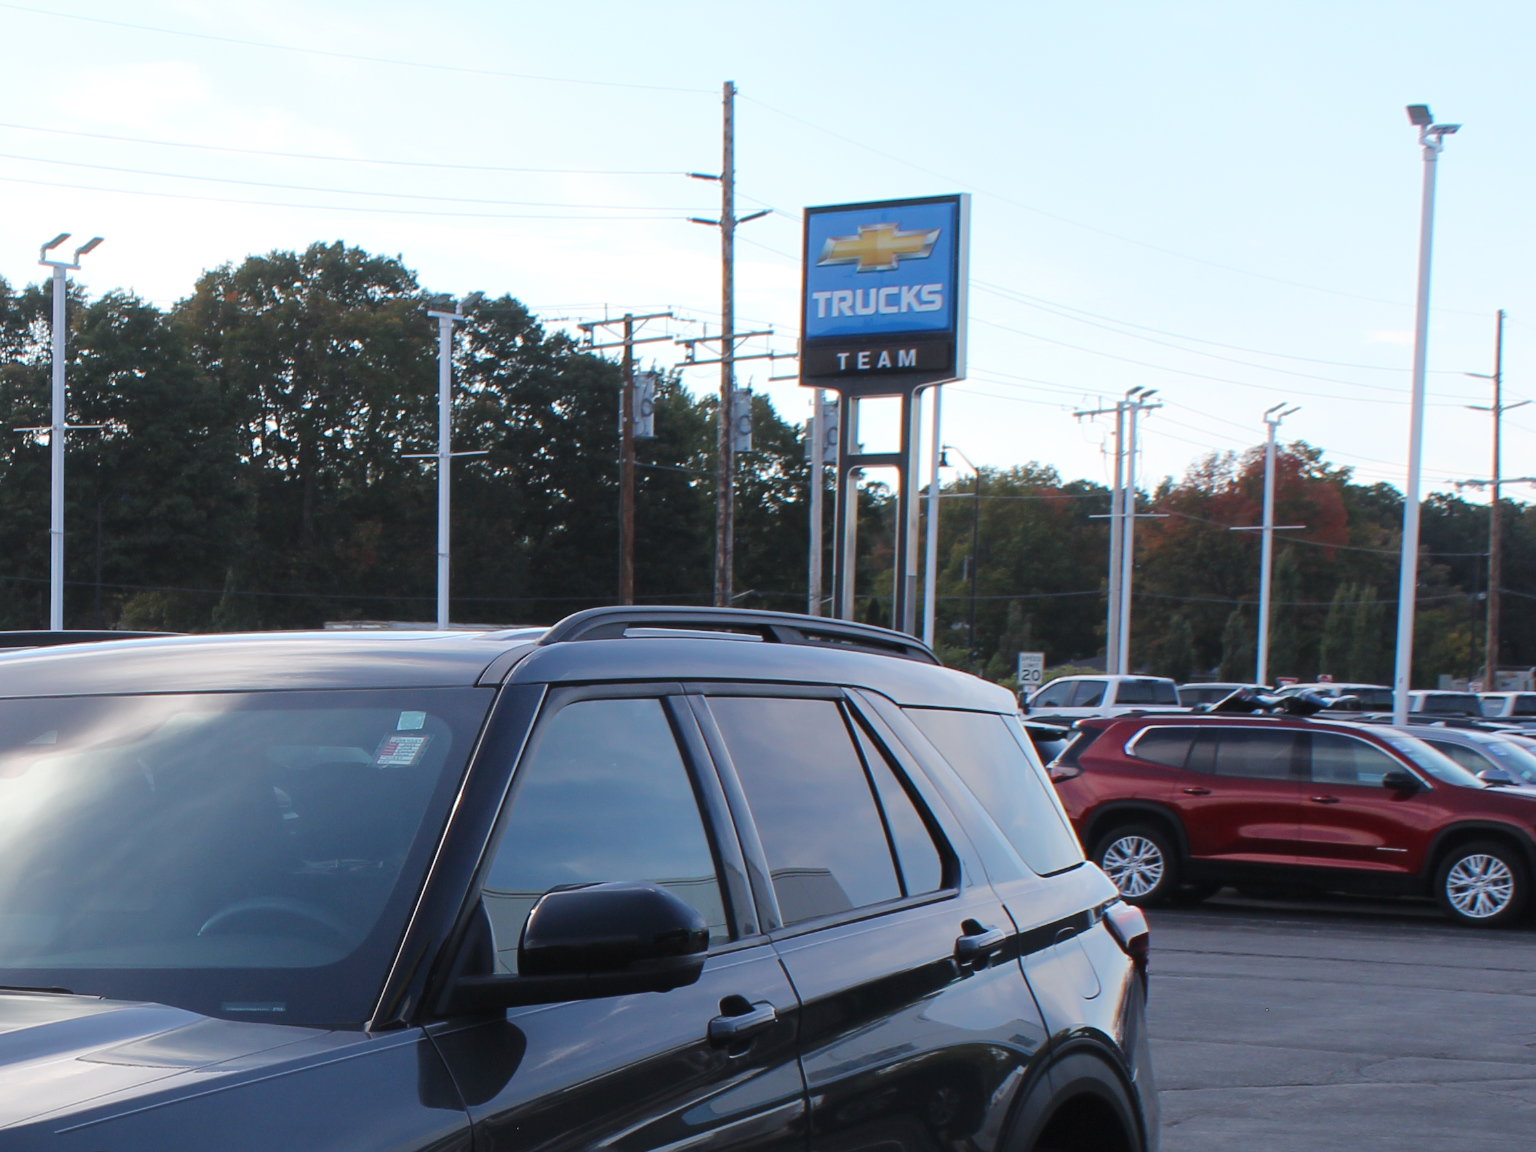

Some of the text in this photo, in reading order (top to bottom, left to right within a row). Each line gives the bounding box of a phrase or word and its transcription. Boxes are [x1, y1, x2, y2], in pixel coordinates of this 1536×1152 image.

[812, 283, 944, 319] TRUCKS
[837, 348, 917, 370] TEAM
[1021, 669, 1041, 681] 20
